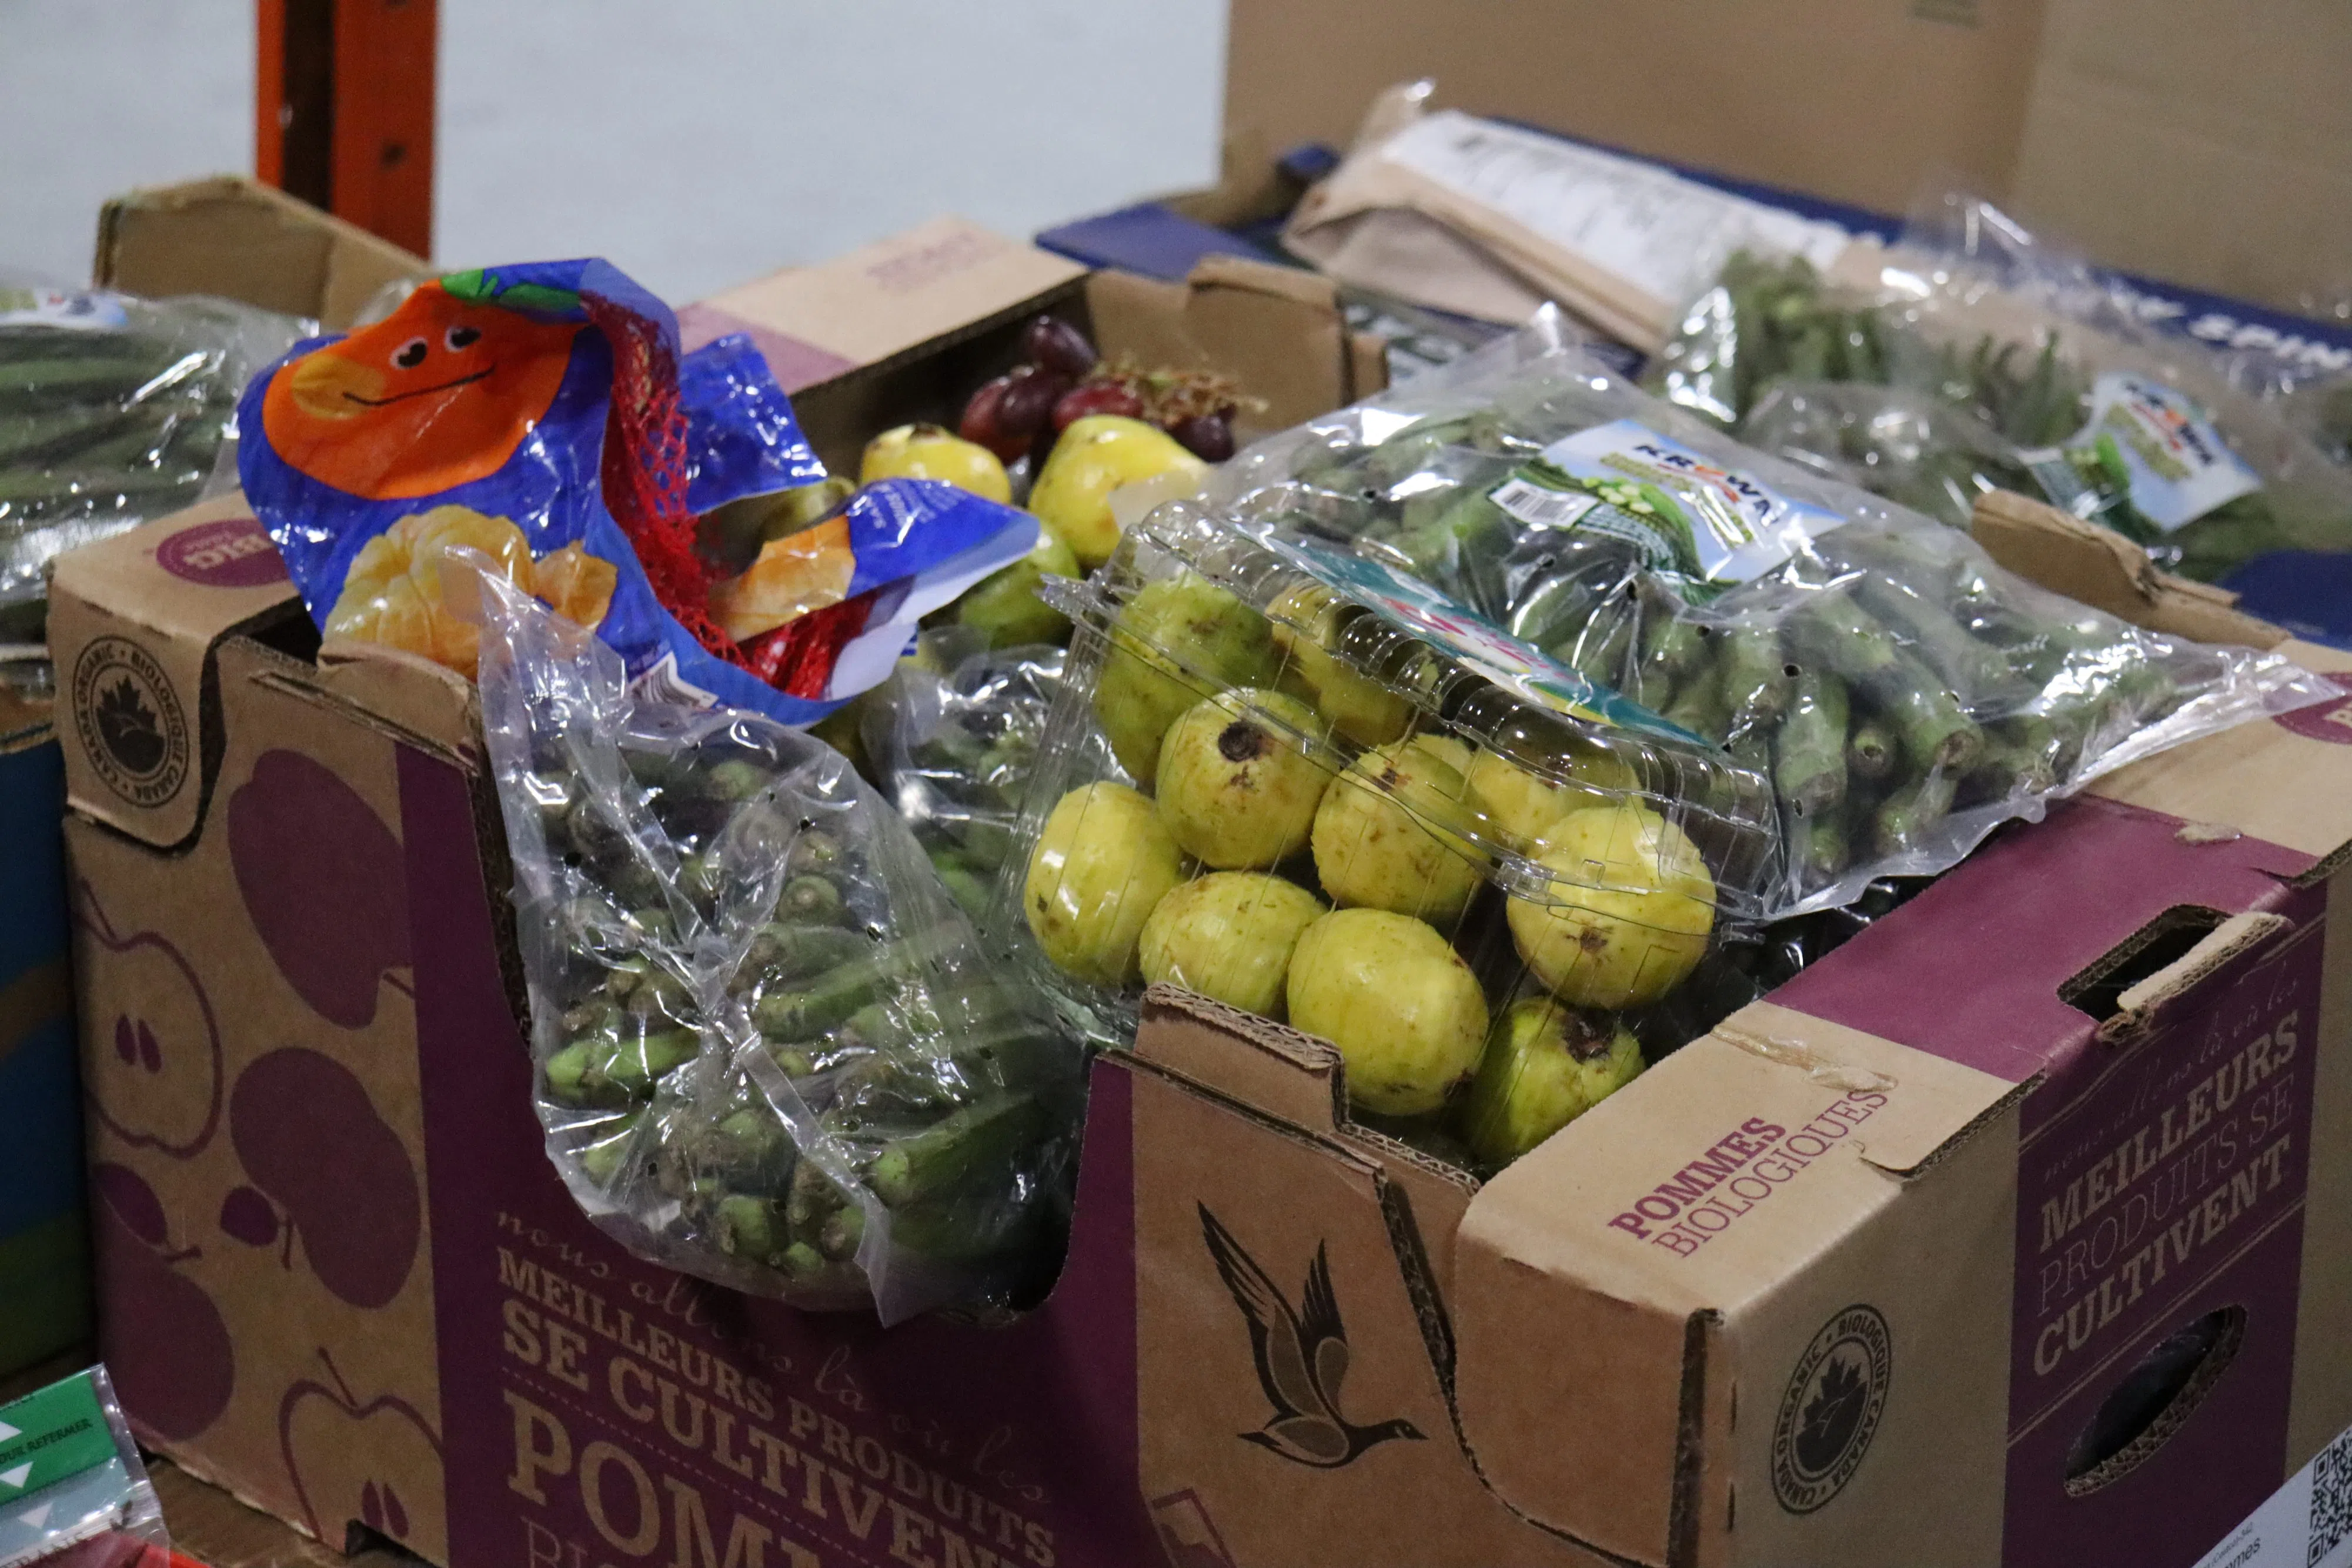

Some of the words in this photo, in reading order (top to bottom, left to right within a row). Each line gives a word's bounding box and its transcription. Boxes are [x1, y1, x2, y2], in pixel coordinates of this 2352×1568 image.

[1608, 1117, 1786, 1240] POMMES
[1651, 1089, 1888, 1258] BIOLOGIQUES
[2038, 1119, 2237, 1316] PRODUITS
[2249, 1074, 2294, 1146] SE
[2040, 1011, 2298, 1253] MEILLEURS
[498, 1211, 613, 1279] nous
[815, 1345, 870, 1412] là
[1838, 1313, 1885, 1395] BIOLOGIQUE
[2034, 1135, 2290, 1376] CULTIVENT
[497, 1246, 775, 1421] MEILLEURS
[788, 1396, 1055, 1567] PRODUITS
[502, 1299, 589, 1392] SE
[609, 1358, 1020, 1568] CULTIVEN
[504, 1388, 821, 1568] POM
